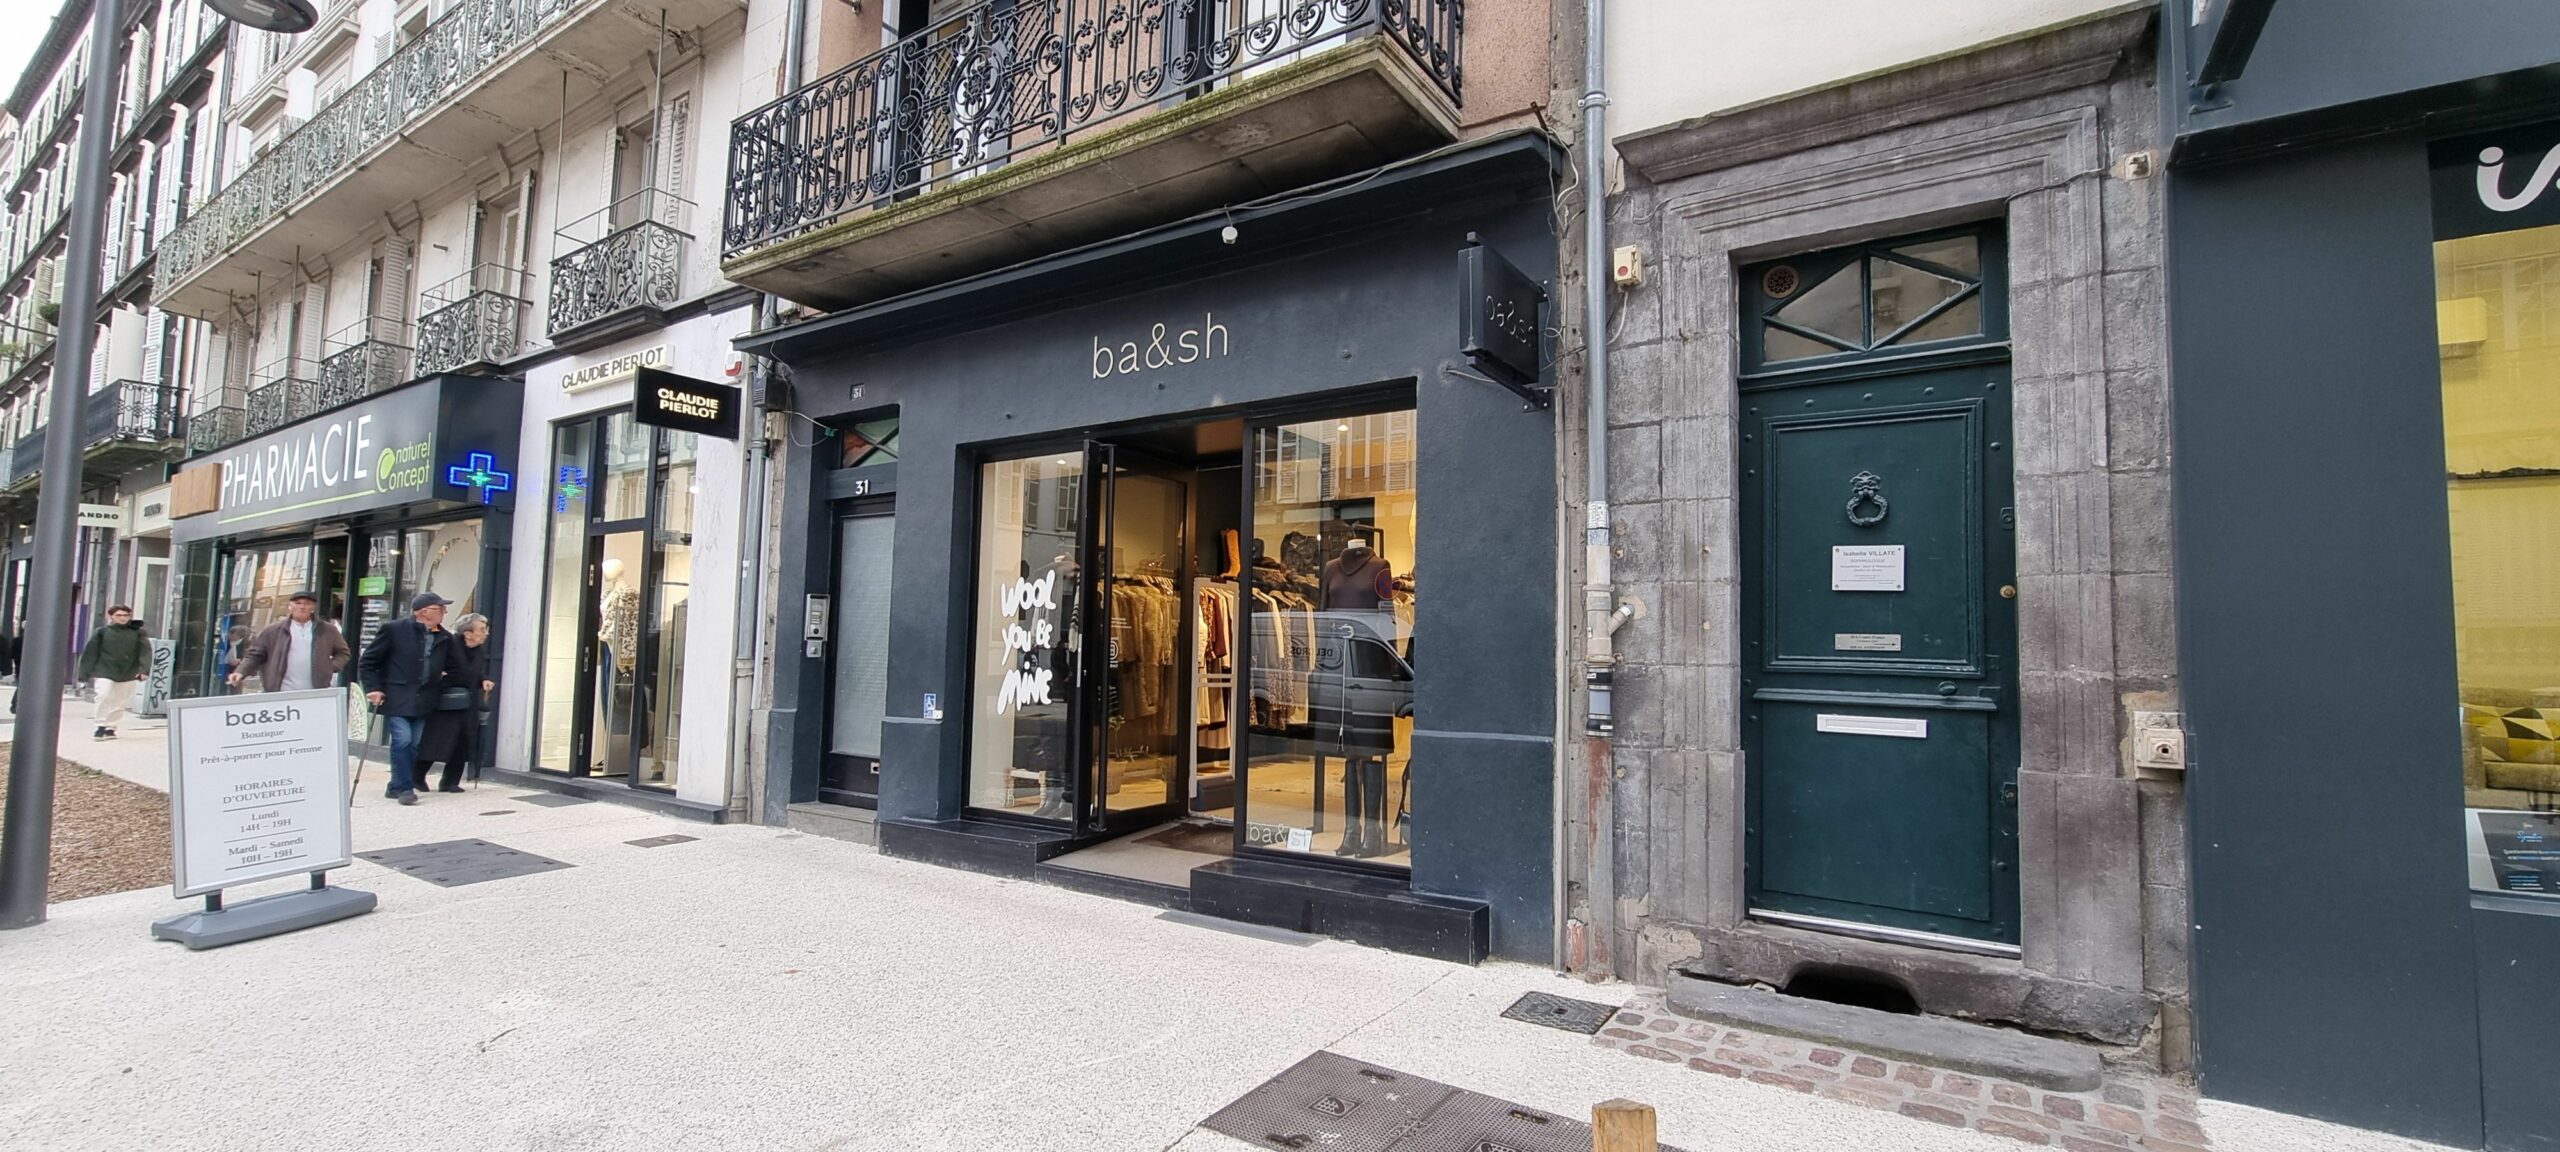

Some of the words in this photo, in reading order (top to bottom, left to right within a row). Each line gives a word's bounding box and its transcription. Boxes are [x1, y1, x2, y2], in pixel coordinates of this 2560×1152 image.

[1093, 312, 1228, 380] ba&sh
[562, 360, 610, 389] CLAUDIE
[611, 347, 664, 375] PIERLOT
[657, 387, 719, 410] CLAUDIE
[659, 399, 718, 420] PIERLOT
[395, 432, 432, 463] naturel
[220, 414, 373, 510] PHARMACIE
[855, 479, 869, 495] 31
[79, 512, 119, 520] ANDRO
[1001, 569, 1057, 617] WOOL
[225, 705, 301, 727] ba&sh
[241, 730, 285, 739] Boutique
[200, 753, 262, 765] Prêt-à-porter
[265, 748, 286, 760] pour
[289, 745, 323, 756] Femme
[234, 778, 294, 792] HORAIRES
[223, 786, 306, 804] D'OUVERTURE
[251, 810, 279, 821] Lundi
[240, 823, 260, 833] 14H
[272, 818, 292, 828] 19H
[228, 844, 258, 856] Mardi
[269, 837, 304, 849] Samedi
[241, 854, 261, 864] 10H
[274, 848, 293, 858] 19H
